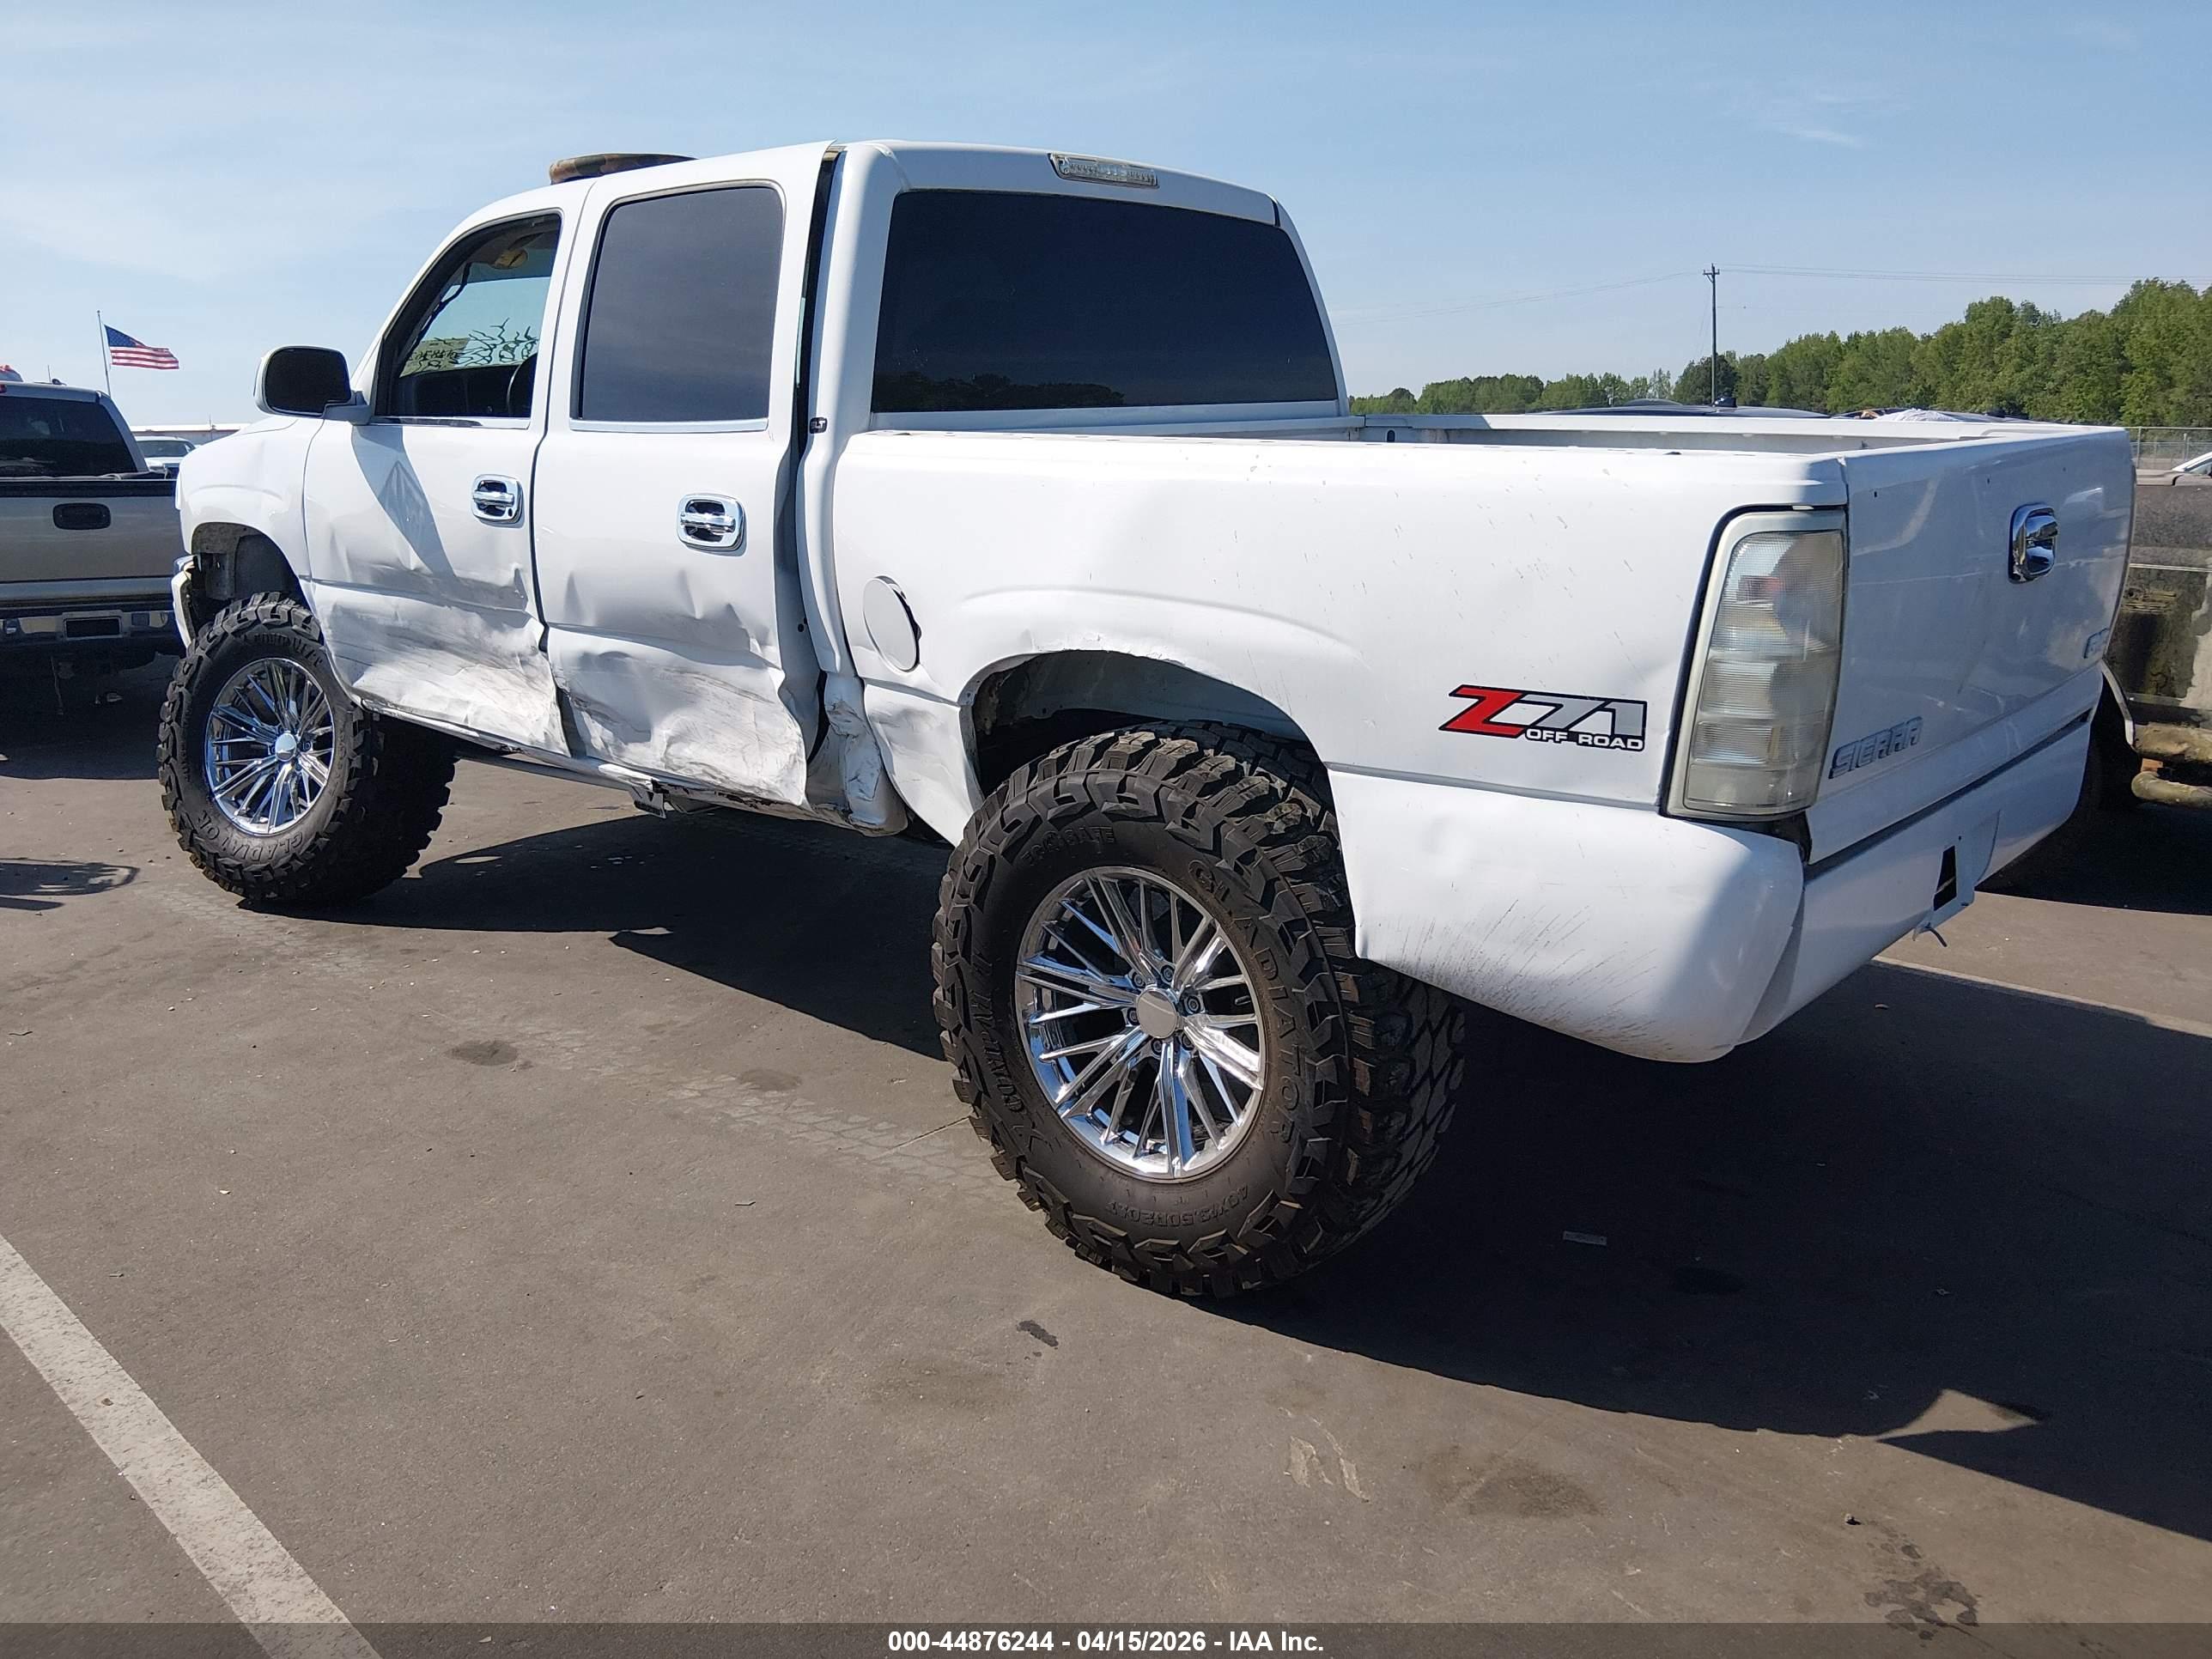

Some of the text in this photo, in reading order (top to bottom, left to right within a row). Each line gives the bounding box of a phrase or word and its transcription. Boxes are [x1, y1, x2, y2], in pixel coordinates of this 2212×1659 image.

[1438, 684, 1648, 738] Z71
[1525, 729, 1644, 750] OFF ROAD
[1828, 716, 1923, 779] SIERRA
[1187, 859, 1303, 1144] GLADIATOR
